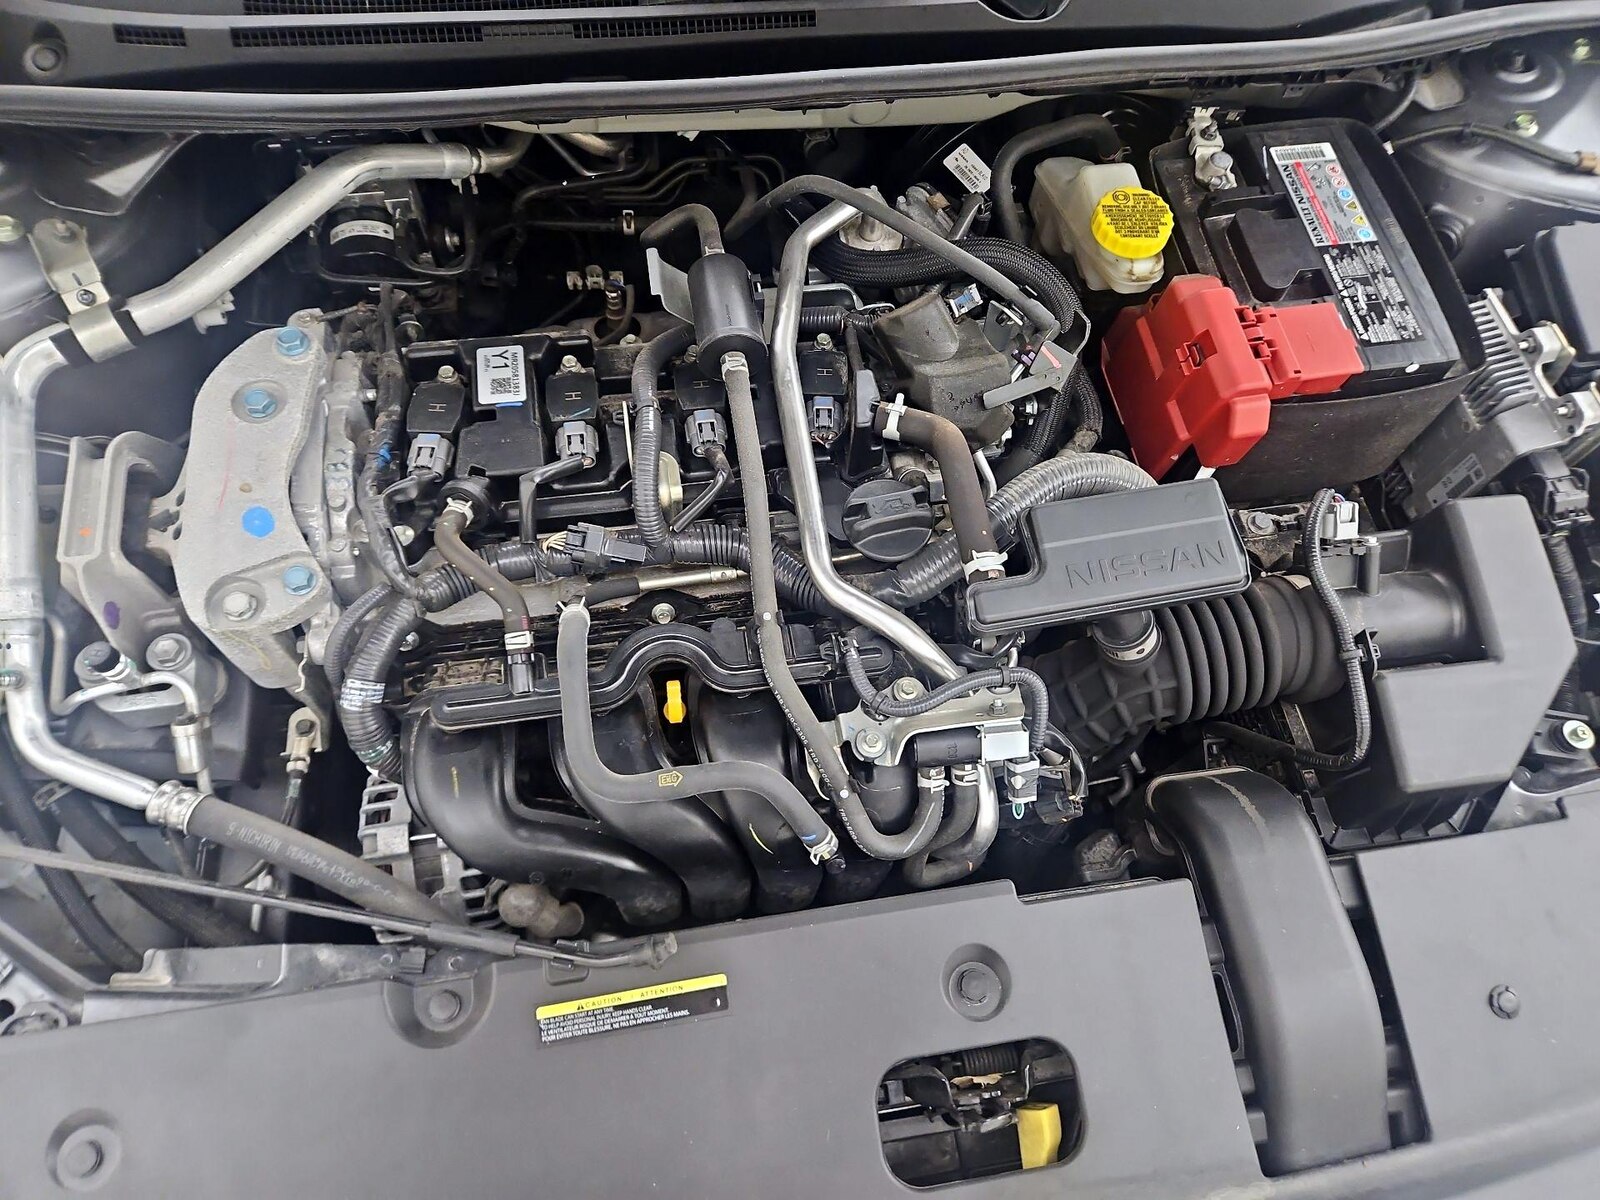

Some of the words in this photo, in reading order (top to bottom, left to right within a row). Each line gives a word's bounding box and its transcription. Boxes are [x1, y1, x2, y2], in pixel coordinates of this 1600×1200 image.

[1282, 164, 1306, 204] NISSAN
[1301, 206, 1325, 244] RENAULT
[491, 349, 510, 368] Y1
[1064, 540, 1225, 589] NISSAN
[585, 996, 622, 1008] CAUTION
[640, 985, 683, 997] ATTENTION
[572, 1028, 588, 1036] TOUTE
[637, 1014, 664, 1024] APPROCHER
